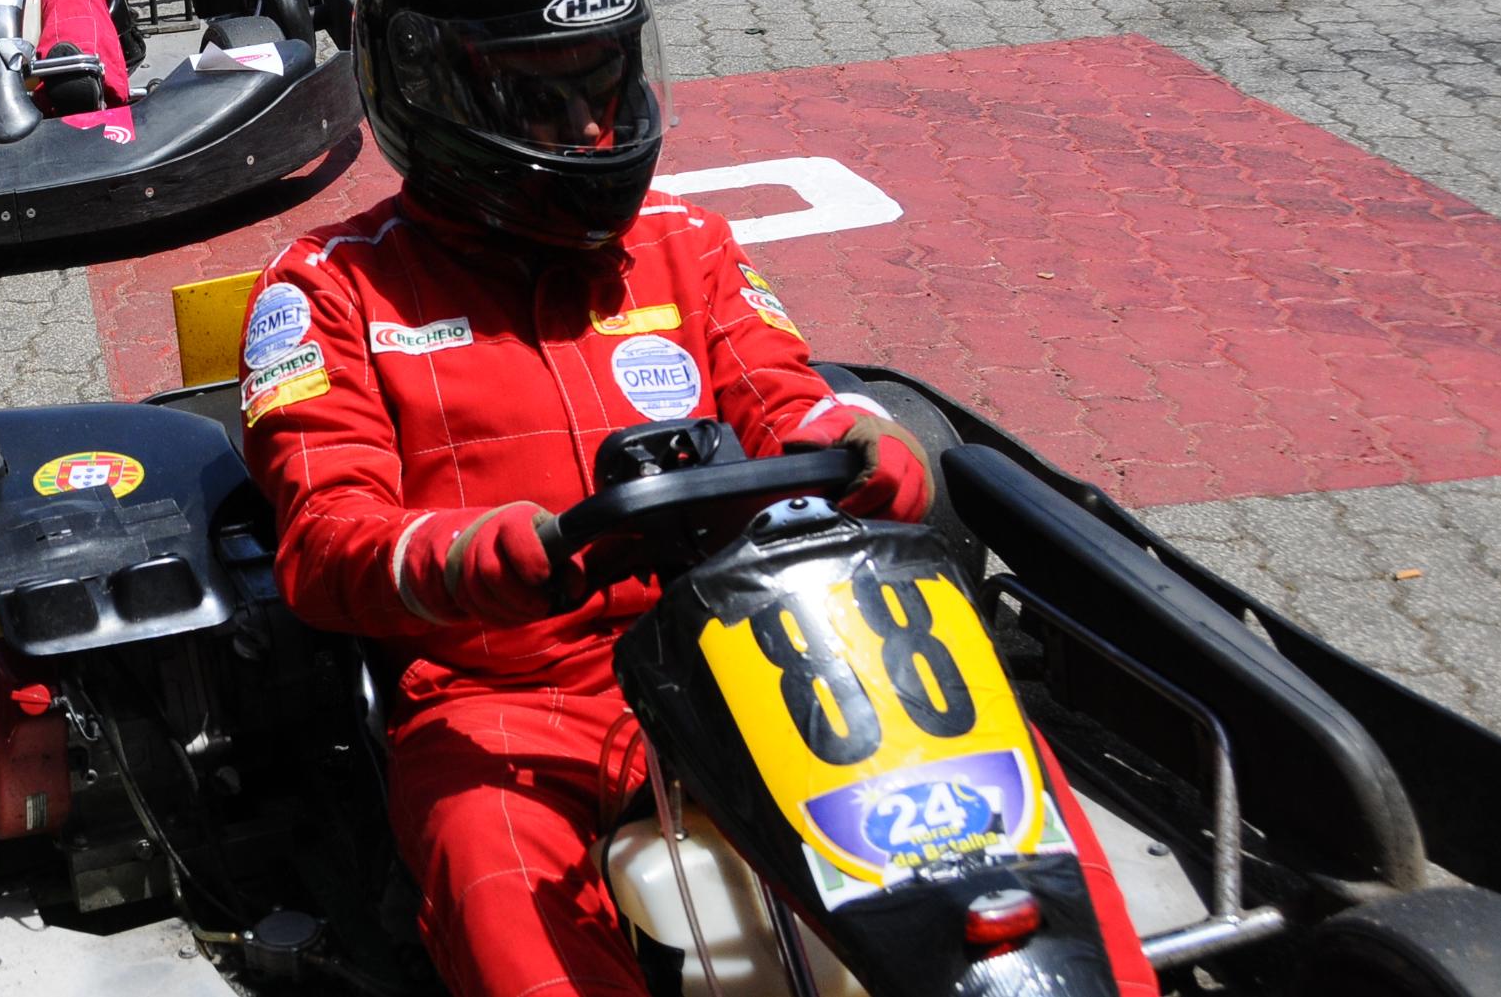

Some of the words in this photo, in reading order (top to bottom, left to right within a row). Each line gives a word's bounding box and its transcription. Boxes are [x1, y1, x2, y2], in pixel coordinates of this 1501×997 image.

[396, 326, 465, 347] RECHEIO
[255, 351, 317, 387] RECHEIO
[623, 364, 691, 388] ORMEI
[749, 571, 977, 766] 88
[876, 782, 968, 845] 24
